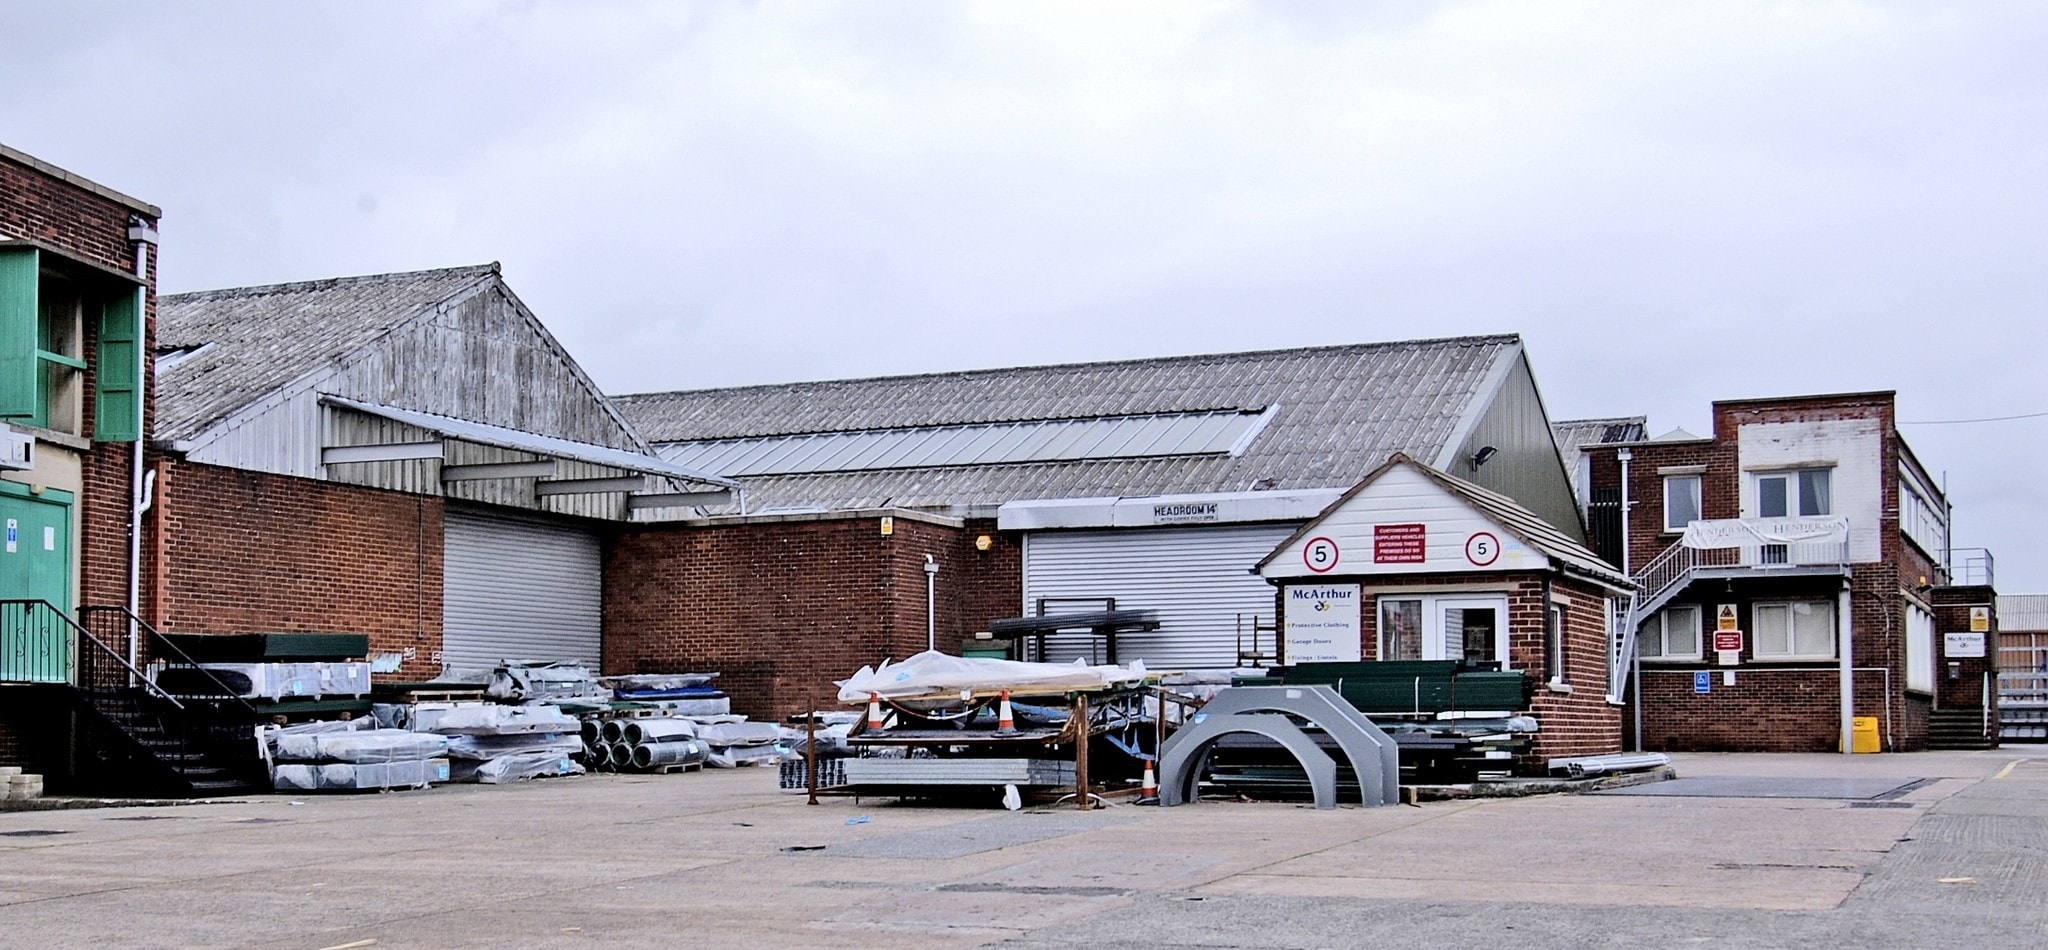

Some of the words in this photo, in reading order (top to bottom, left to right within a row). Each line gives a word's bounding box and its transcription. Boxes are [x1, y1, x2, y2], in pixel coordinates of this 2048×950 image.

[1154, 504, 1205, 516] HEADROOM
[1773, 521, 1845, 534] HENDERSON
[1315, 545, 1327, 563] 5
[1477, 542, 1487, 555] 5
[1292, 588, 1353, 599] McArthur
